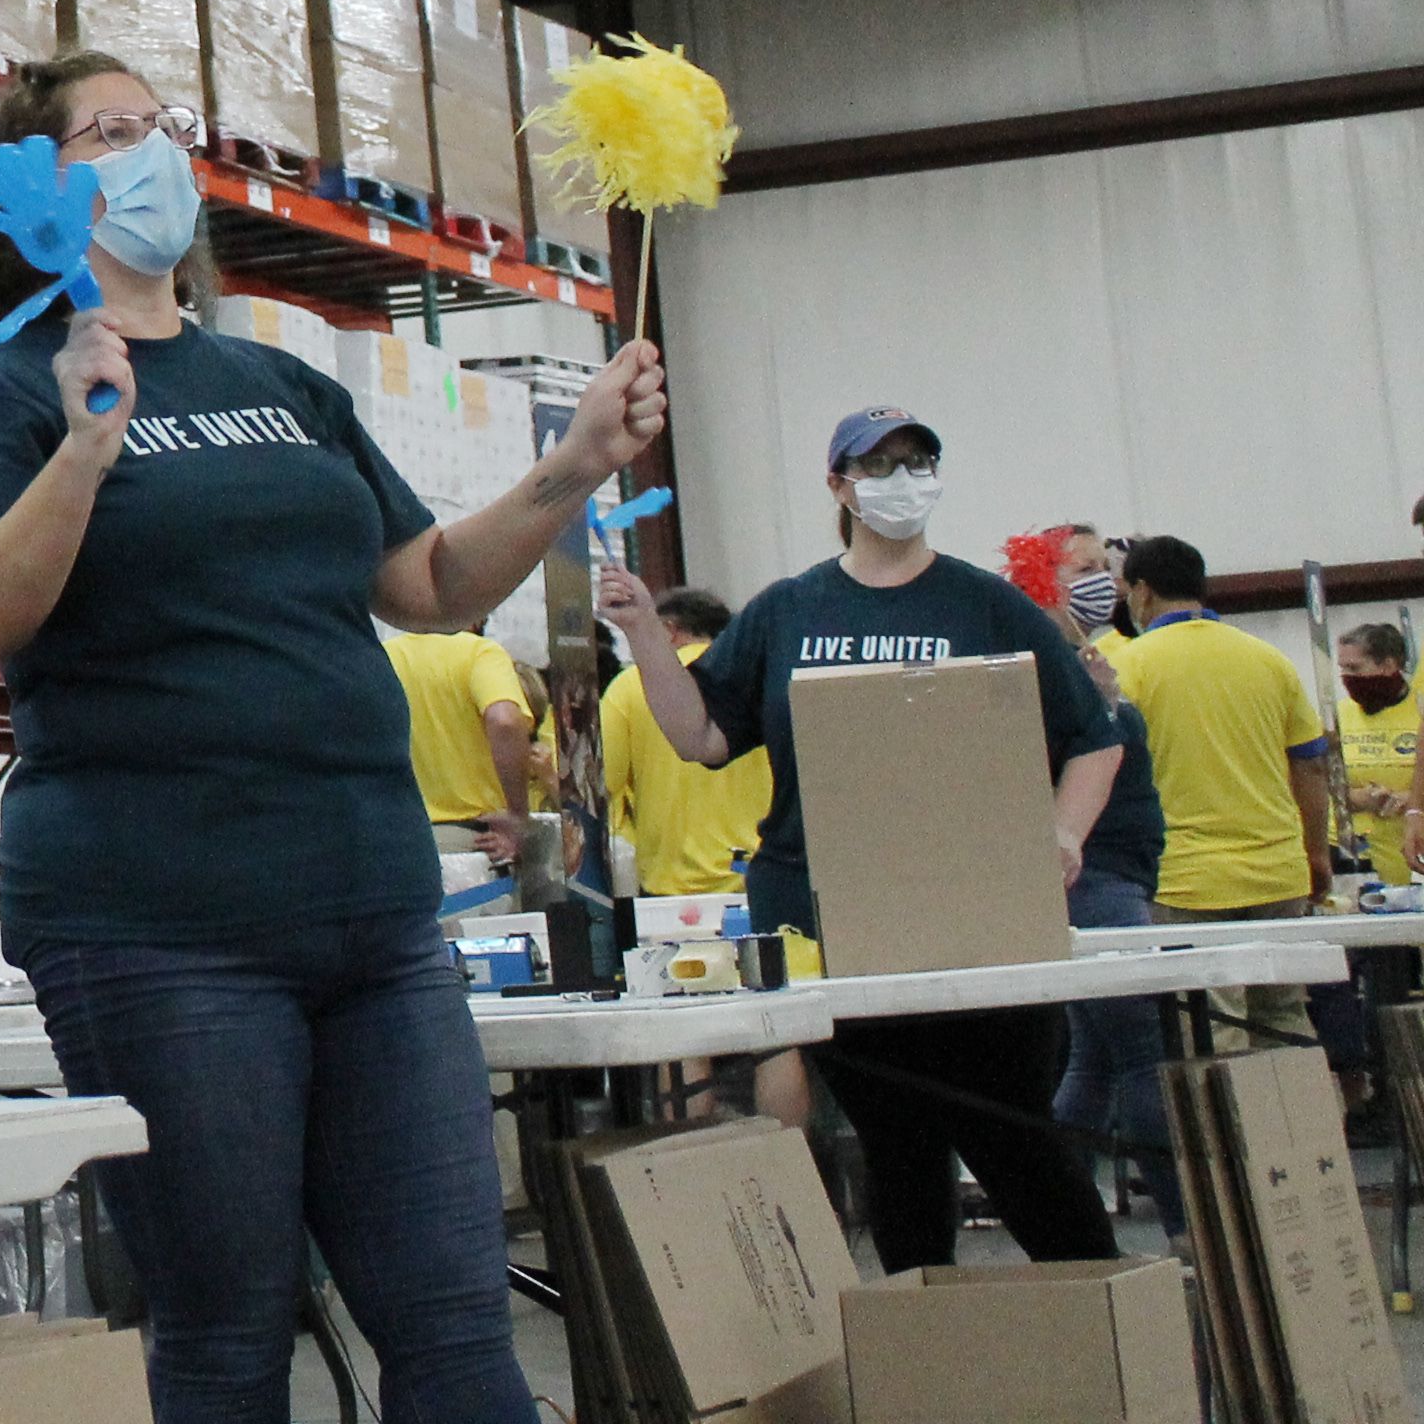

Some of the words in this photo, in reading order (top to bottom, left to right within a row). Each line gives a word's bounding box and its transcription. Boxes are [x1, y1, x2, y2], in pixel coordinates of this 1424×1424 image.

[123, 416, 201, 456] LIVE
[799, 636, 854, 661] LIVE
[861, 635, 951, 661] UNITED
